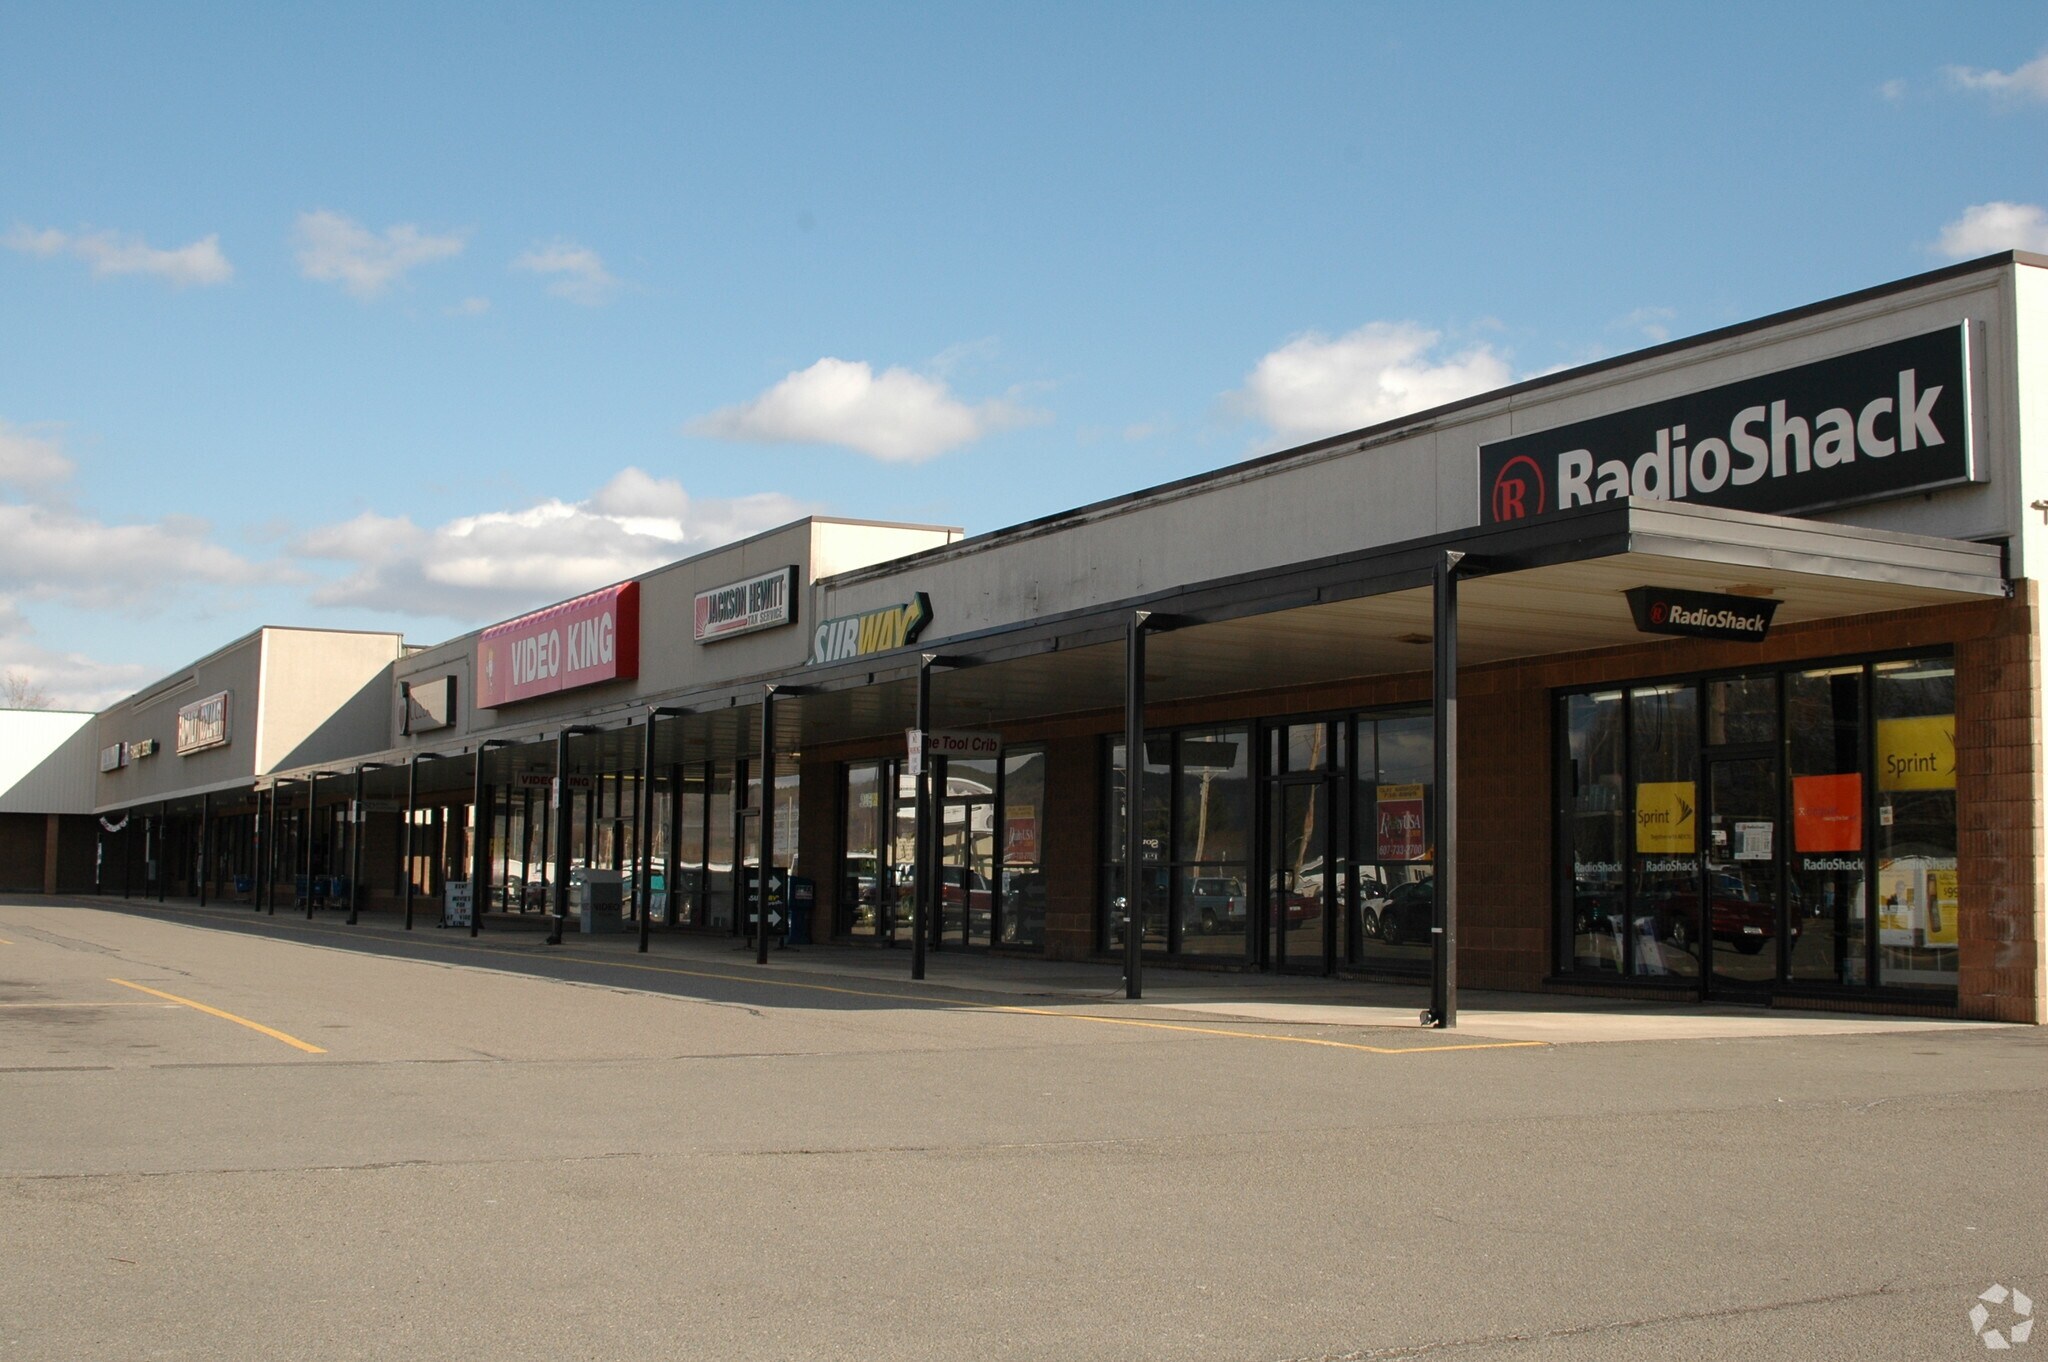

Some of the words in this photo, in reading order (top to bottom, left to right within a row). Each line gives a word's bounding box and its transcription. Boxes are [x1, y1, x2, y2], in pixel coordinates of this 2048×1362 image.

[1558, 368, 1945, 510] RadioShack
[709, 584, 747, 624] JACKSON
[749, 574, 784, 614] HEWITT
[747, 614, 759, 626] TAX
[760, 607, 783, 623] SERVICE
[1669, 605, 1766, 632] RadioShack
[806, 599, 919, 666] SUBWAY
[511, 628, 560, 686] VIDEO
[567, 611, 613, 672] KING
[942, 736, 969, 750] Tool
[972, 737, 998, 752] Crib
[1887, 752, 1938, 779] Sprint
[569, 777, 589, 787] ING
[1638, 809, 1670, 827] Sprint
[1574, 861, 1623, 872] RadioShack
[1645, 859, 1699, 872] RadioShack
[1803, 858, 1864, 871] RadioShack
